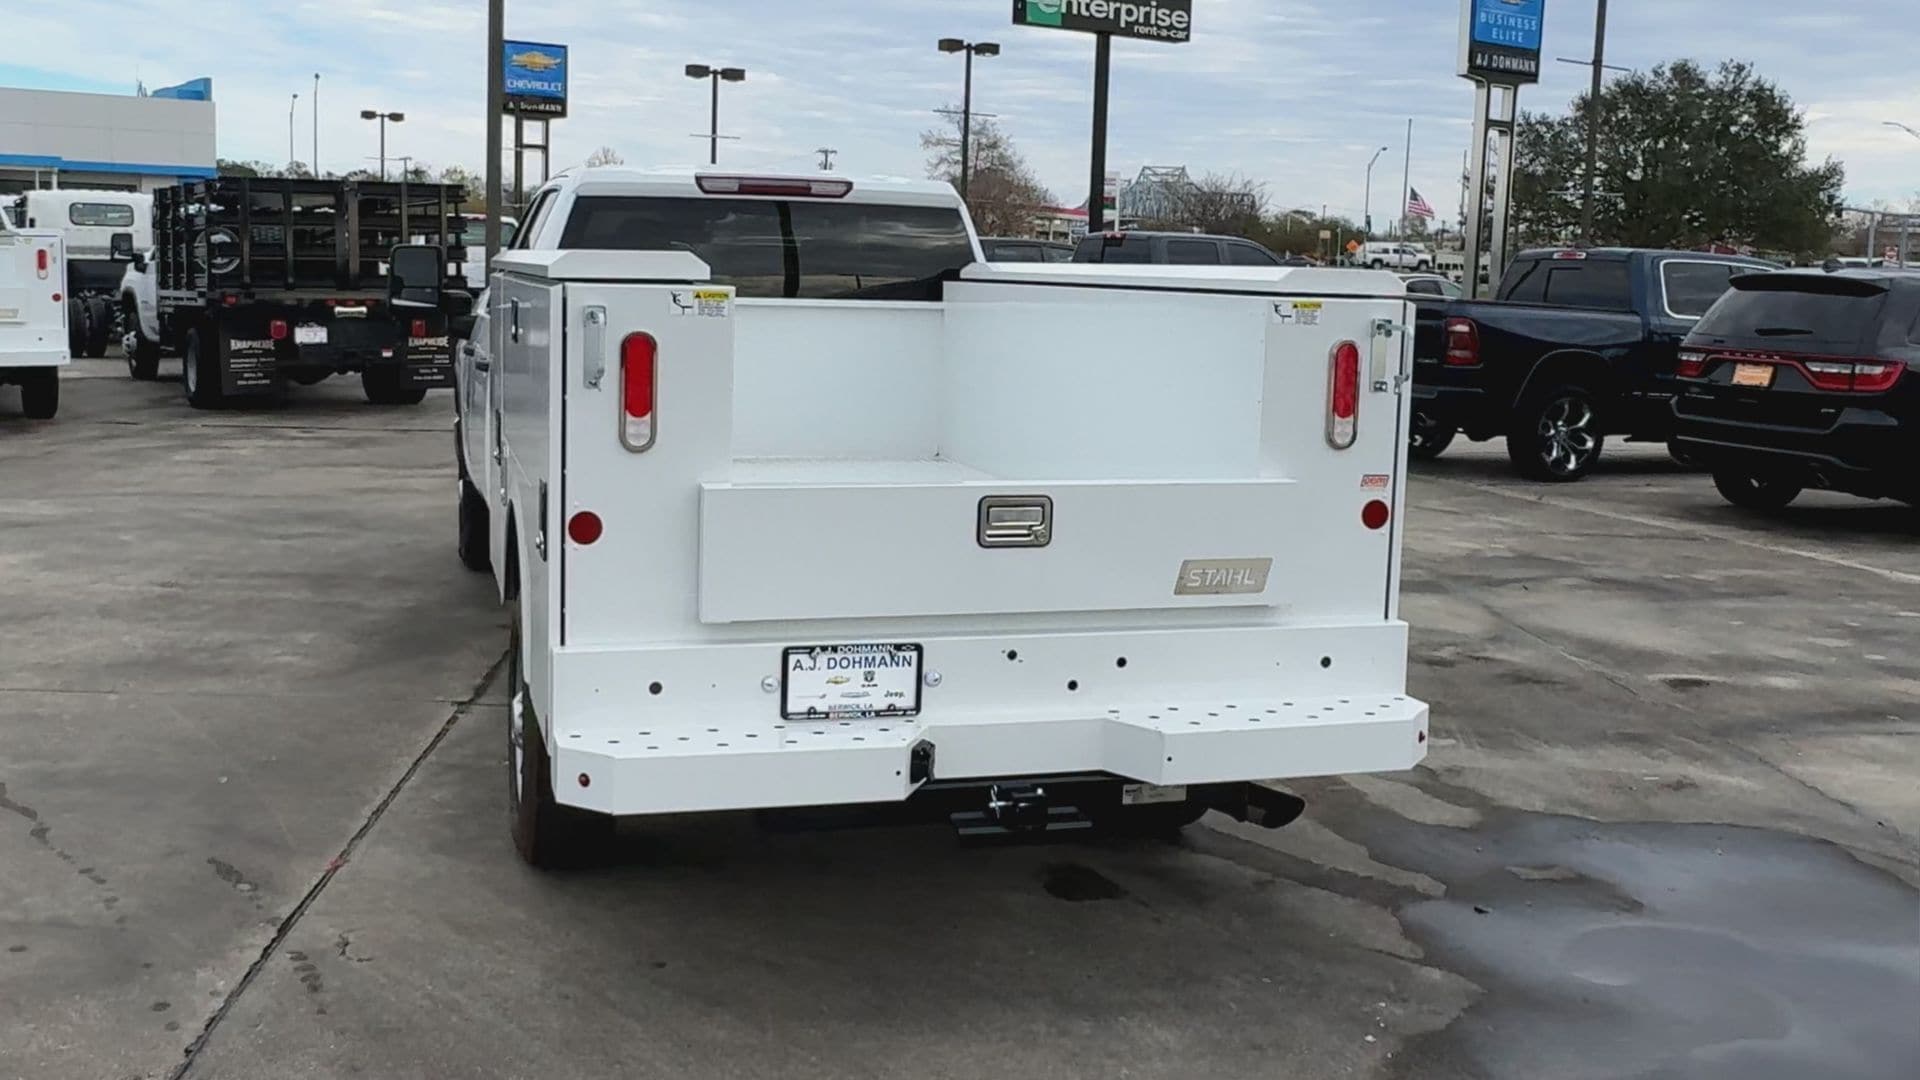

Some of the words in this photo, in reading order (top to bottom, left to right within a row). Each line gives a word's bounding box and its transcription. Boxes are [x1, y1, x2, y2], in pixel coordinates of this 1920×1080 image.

[1038, 0, 1188, 28] enterprise
[1480, 12, 1537, 30] BUSINESS
[1134, 26, 1188, 39] rent-a-car
[1492, 27, 1524, 43] ELITE
[1475, 52, 1489, 67] AJ
[1492, 55, 1536, 72] DOHMANN
[507, 79, 562, 91] CHEVROLET
[1437, 263, 1488, 271] BERK
[1186, 568, 1256, 587] STAHL
[792, 659, 821, 672] A.J.
[826, 655, 913, 670] DOHMANN
